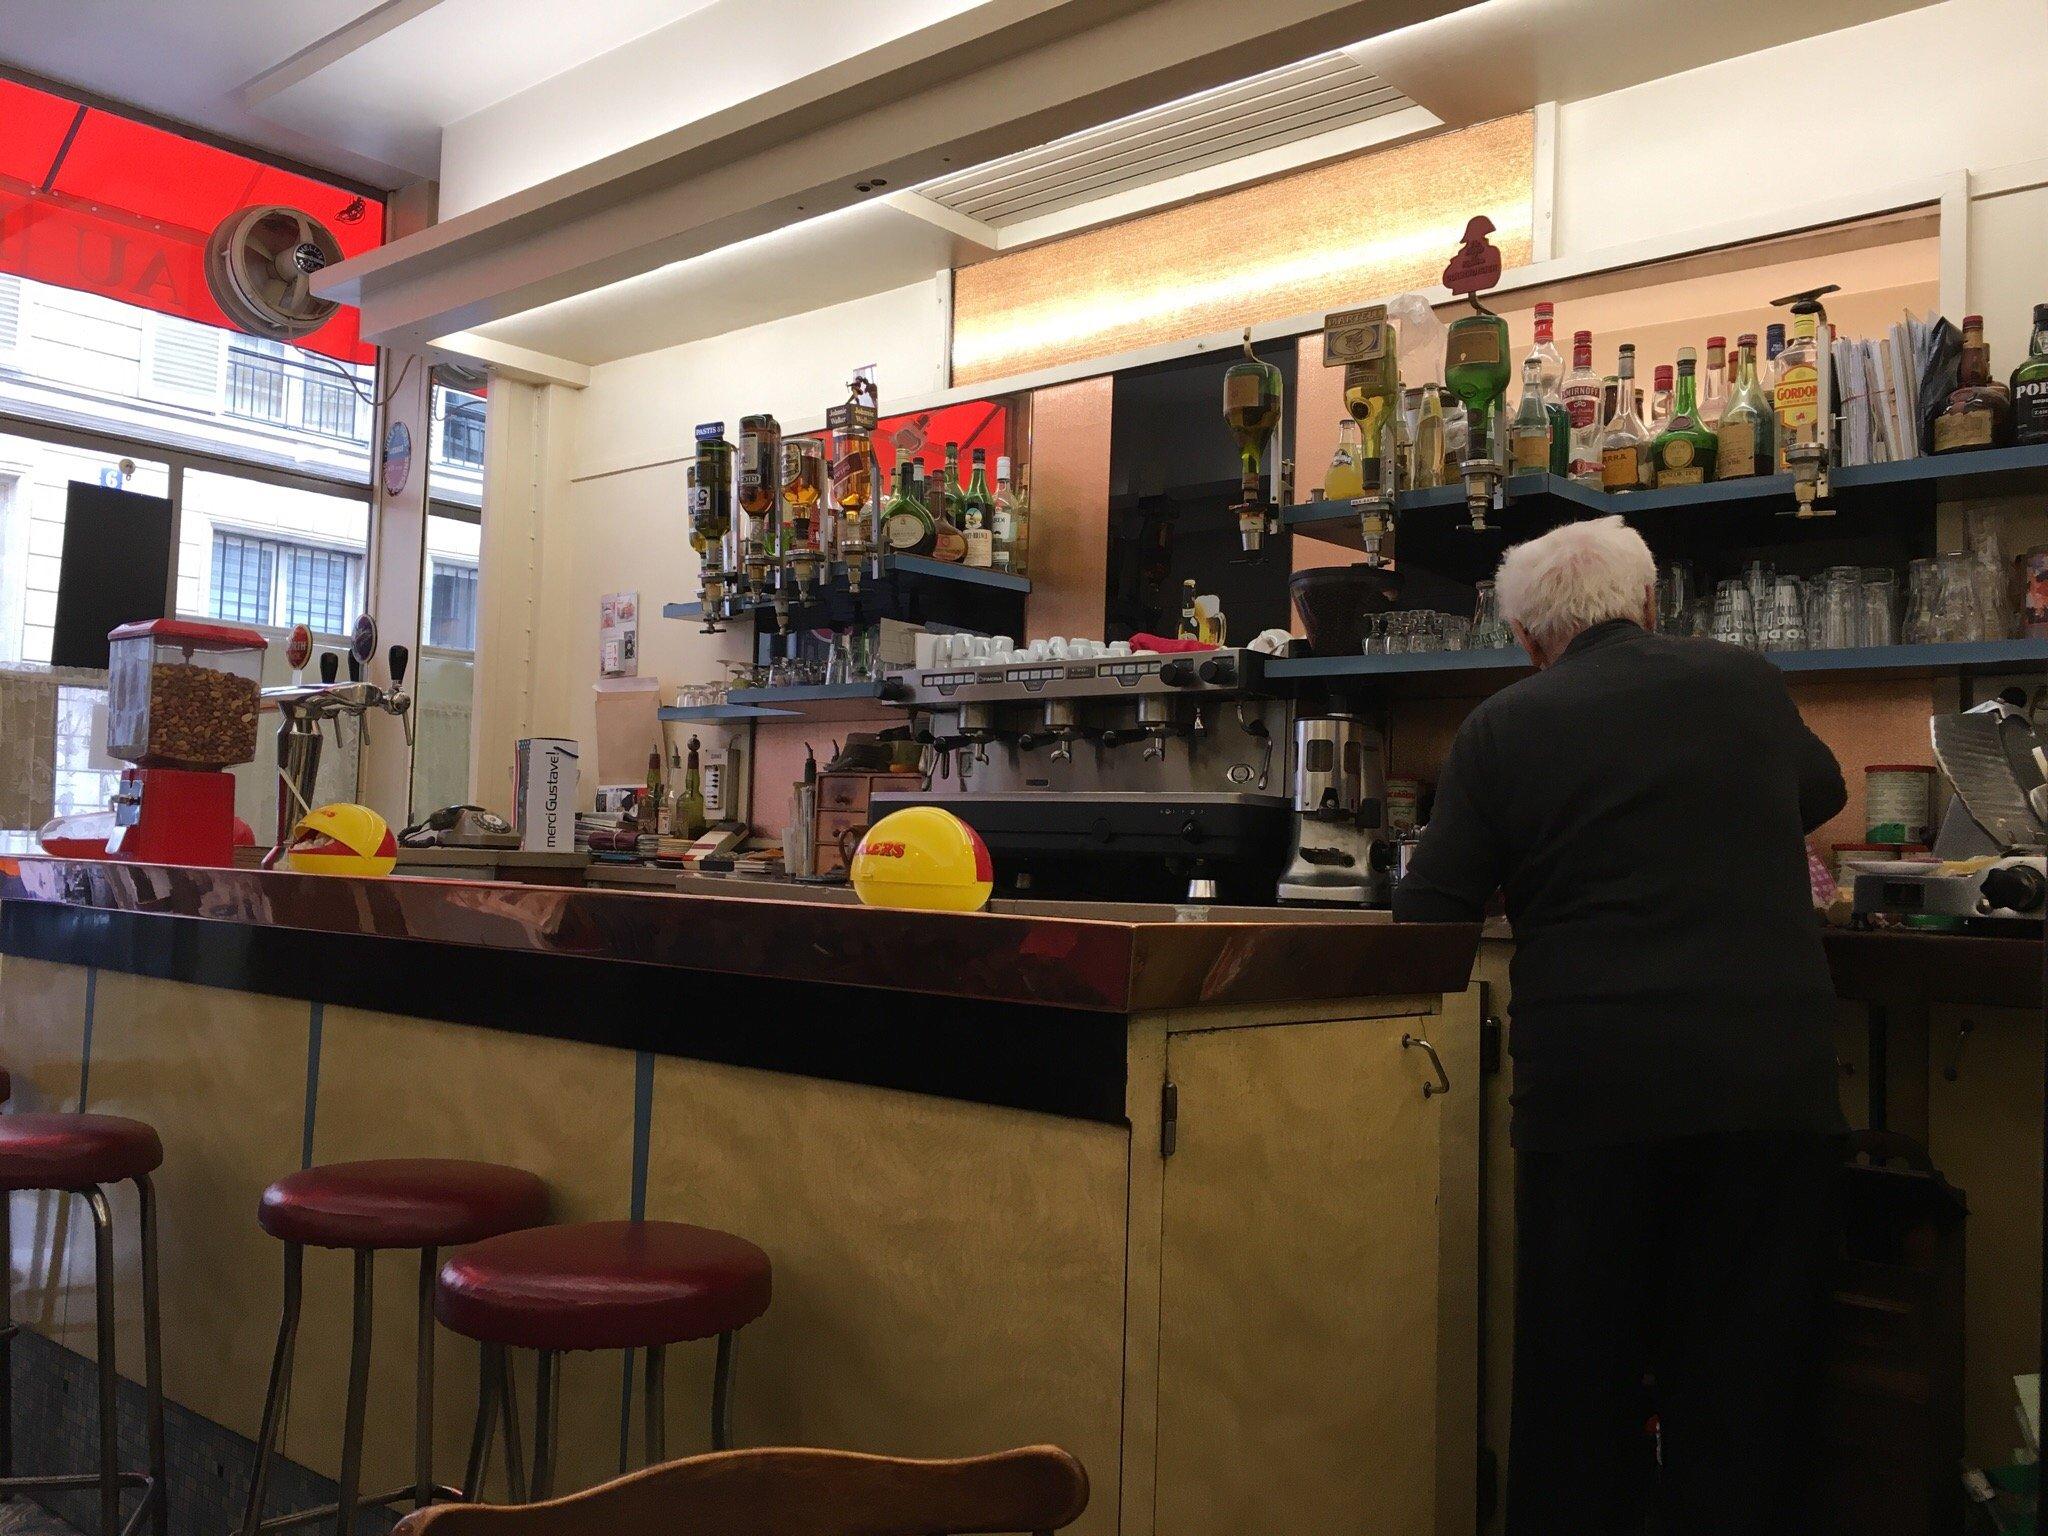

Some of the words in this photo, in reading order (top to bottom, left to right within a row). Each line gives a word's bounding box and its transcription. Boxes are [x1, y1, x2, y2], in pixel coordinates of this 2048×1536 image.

[1562, 385, 1600, 399] SMIRNOFF
[829, 406, 848, 418] Johnnie
[696, 426, 717, 437] PASTIS
[546, 751, 561, 811] Gustave!
[546, 813, 556, 848] merci
